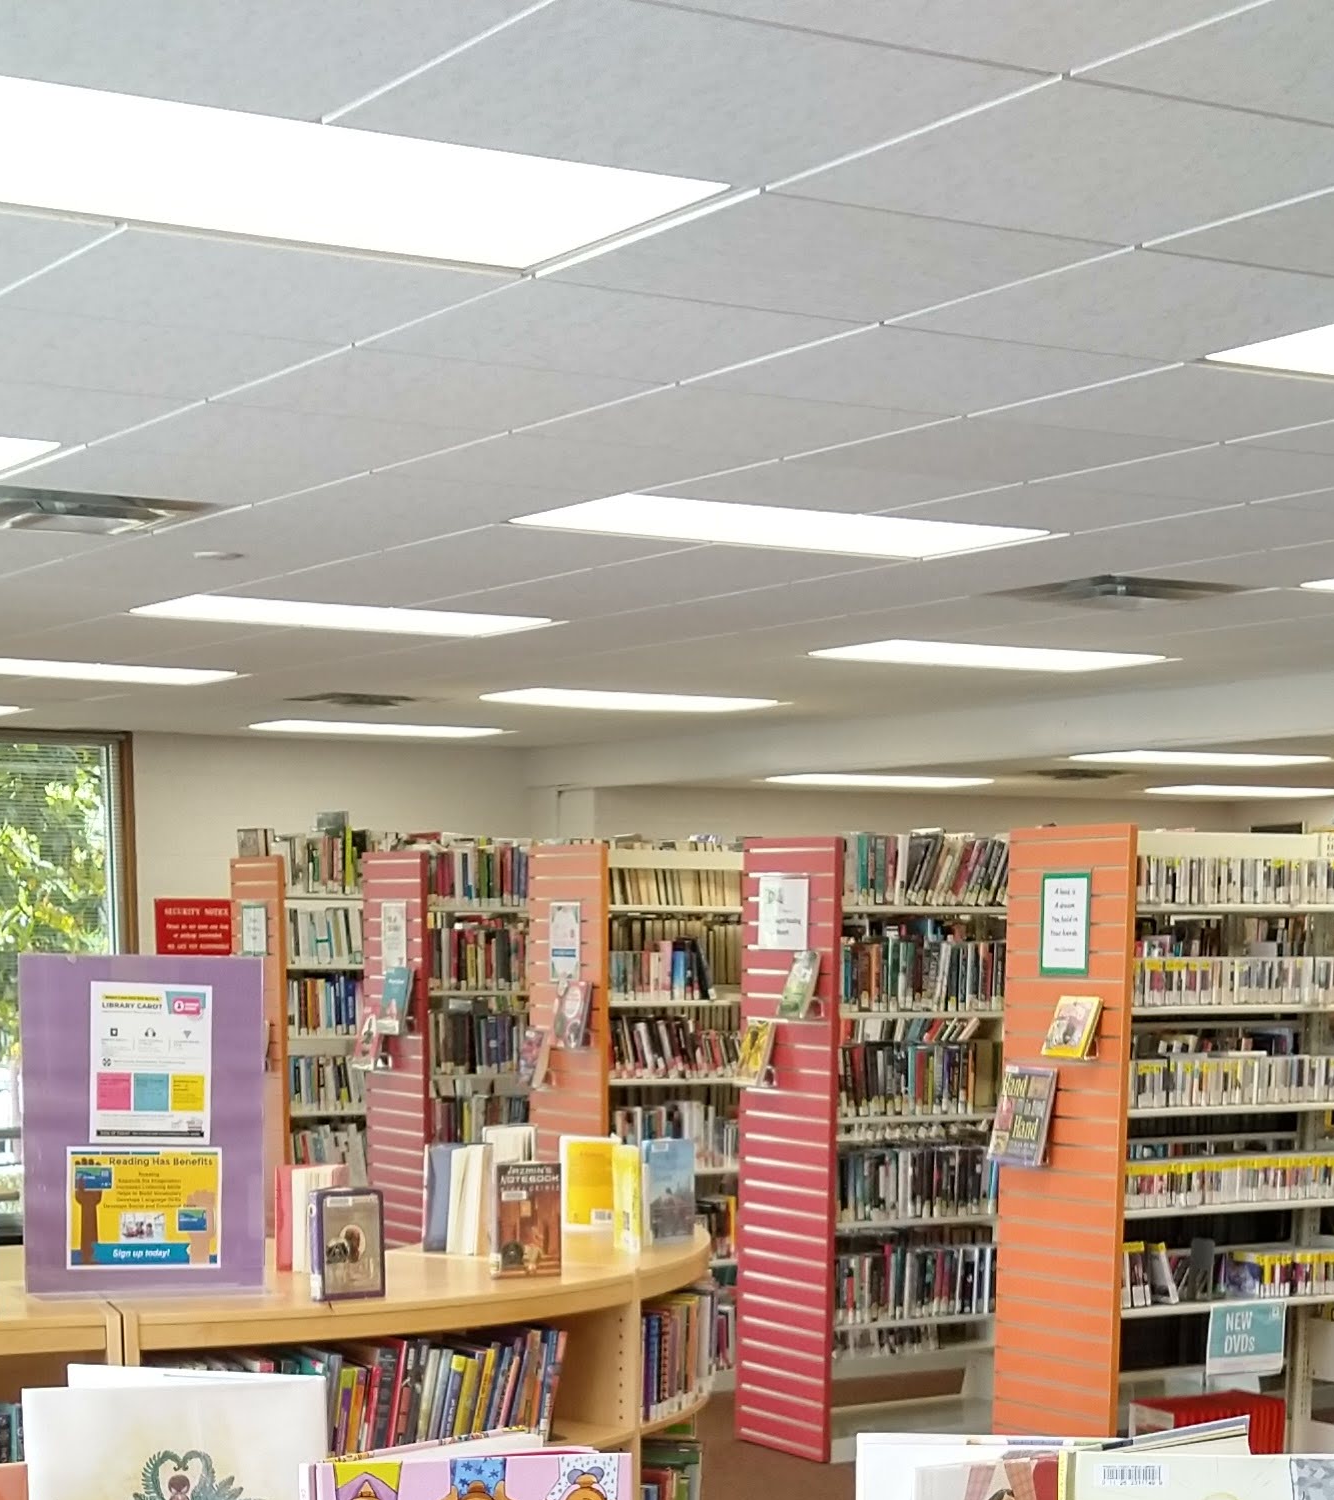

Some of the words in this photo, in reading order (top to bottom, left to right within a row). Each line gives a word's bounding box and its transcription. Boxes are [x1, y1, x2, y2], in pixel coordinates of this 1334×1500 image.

[164, 907, 201, 916] SECURITY
[204, 907, 229, 917] NOTICE
[102, 1001, 134, 1009] LIBRARY
[1002, 1072, 1028, 1099] Hand
[1012, 1115, 1039, 1140] Hand
[109, 1157, 150, 1166] Reading
[152, 1157, 171, 1166] Has
[173, 1157, 213, 1166] Benefits
[500, 1175, 559, 1185] NOTEBOOK
[113, 1249, 132, 1259] Sign
[133, 1250, 144, 1259] up
[145, 1248, 171, 1259] today!
[1225, 1311, 1253, 1332] NEW
[1224, 1333, 1256, 1354] DVDs
